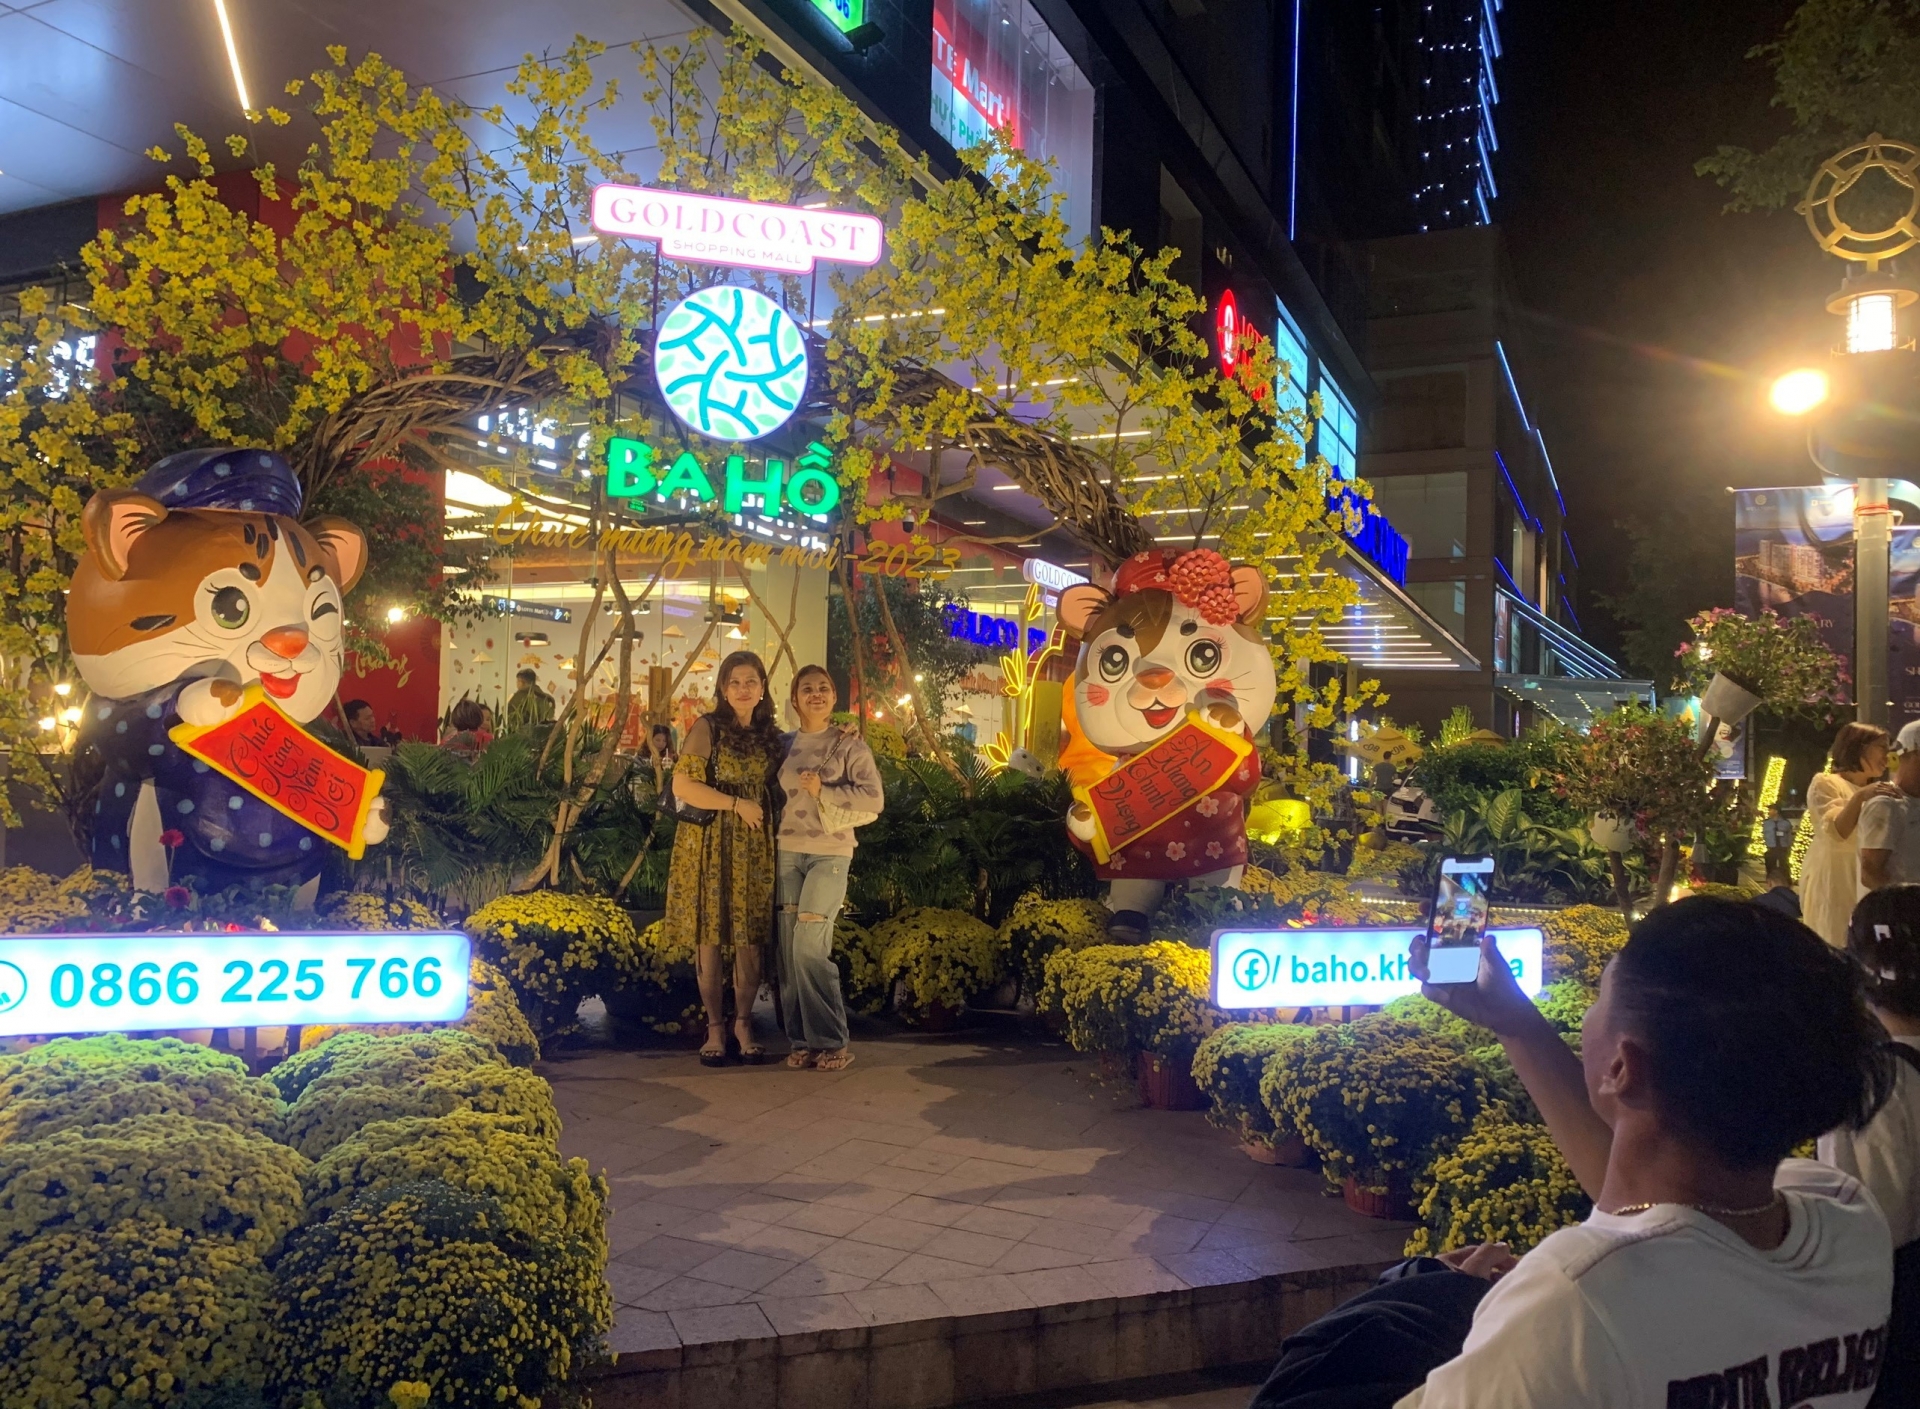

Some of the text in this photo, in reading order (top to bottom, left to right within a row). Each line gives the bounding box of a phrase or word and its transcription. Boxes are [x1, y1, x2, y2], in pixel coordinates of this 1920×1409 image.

[962, 57, 1004, 127] Mart
[609, 198, 865, 251] GOLDCOAST
[672, 239, 802, 265] SHOPPING MALL
[607, 437, 716, 503] BA
[723, 442, 840, 517] HỒ
[492, 500, 590, 548] Chúc
[598, 520, 696, 580] mừng
[701, 529, 774, 565] năm
[857, 540, 961, 581] 2023
[225, 716, 275, 778] Chúc
[259, 735, 303, 797] Mừng
[1151, 747, 1198, 807] Khang
[1169, 735, 1212, 776] An
[287, 758, 324, 812] Năm
[305, 770, 355, 832] Mới
[1095, 774, 1141, 836] Vượng
[1125, 757, 1173, 810] Thịnh
[50, 957, 442, 1008] 0866 225 766
